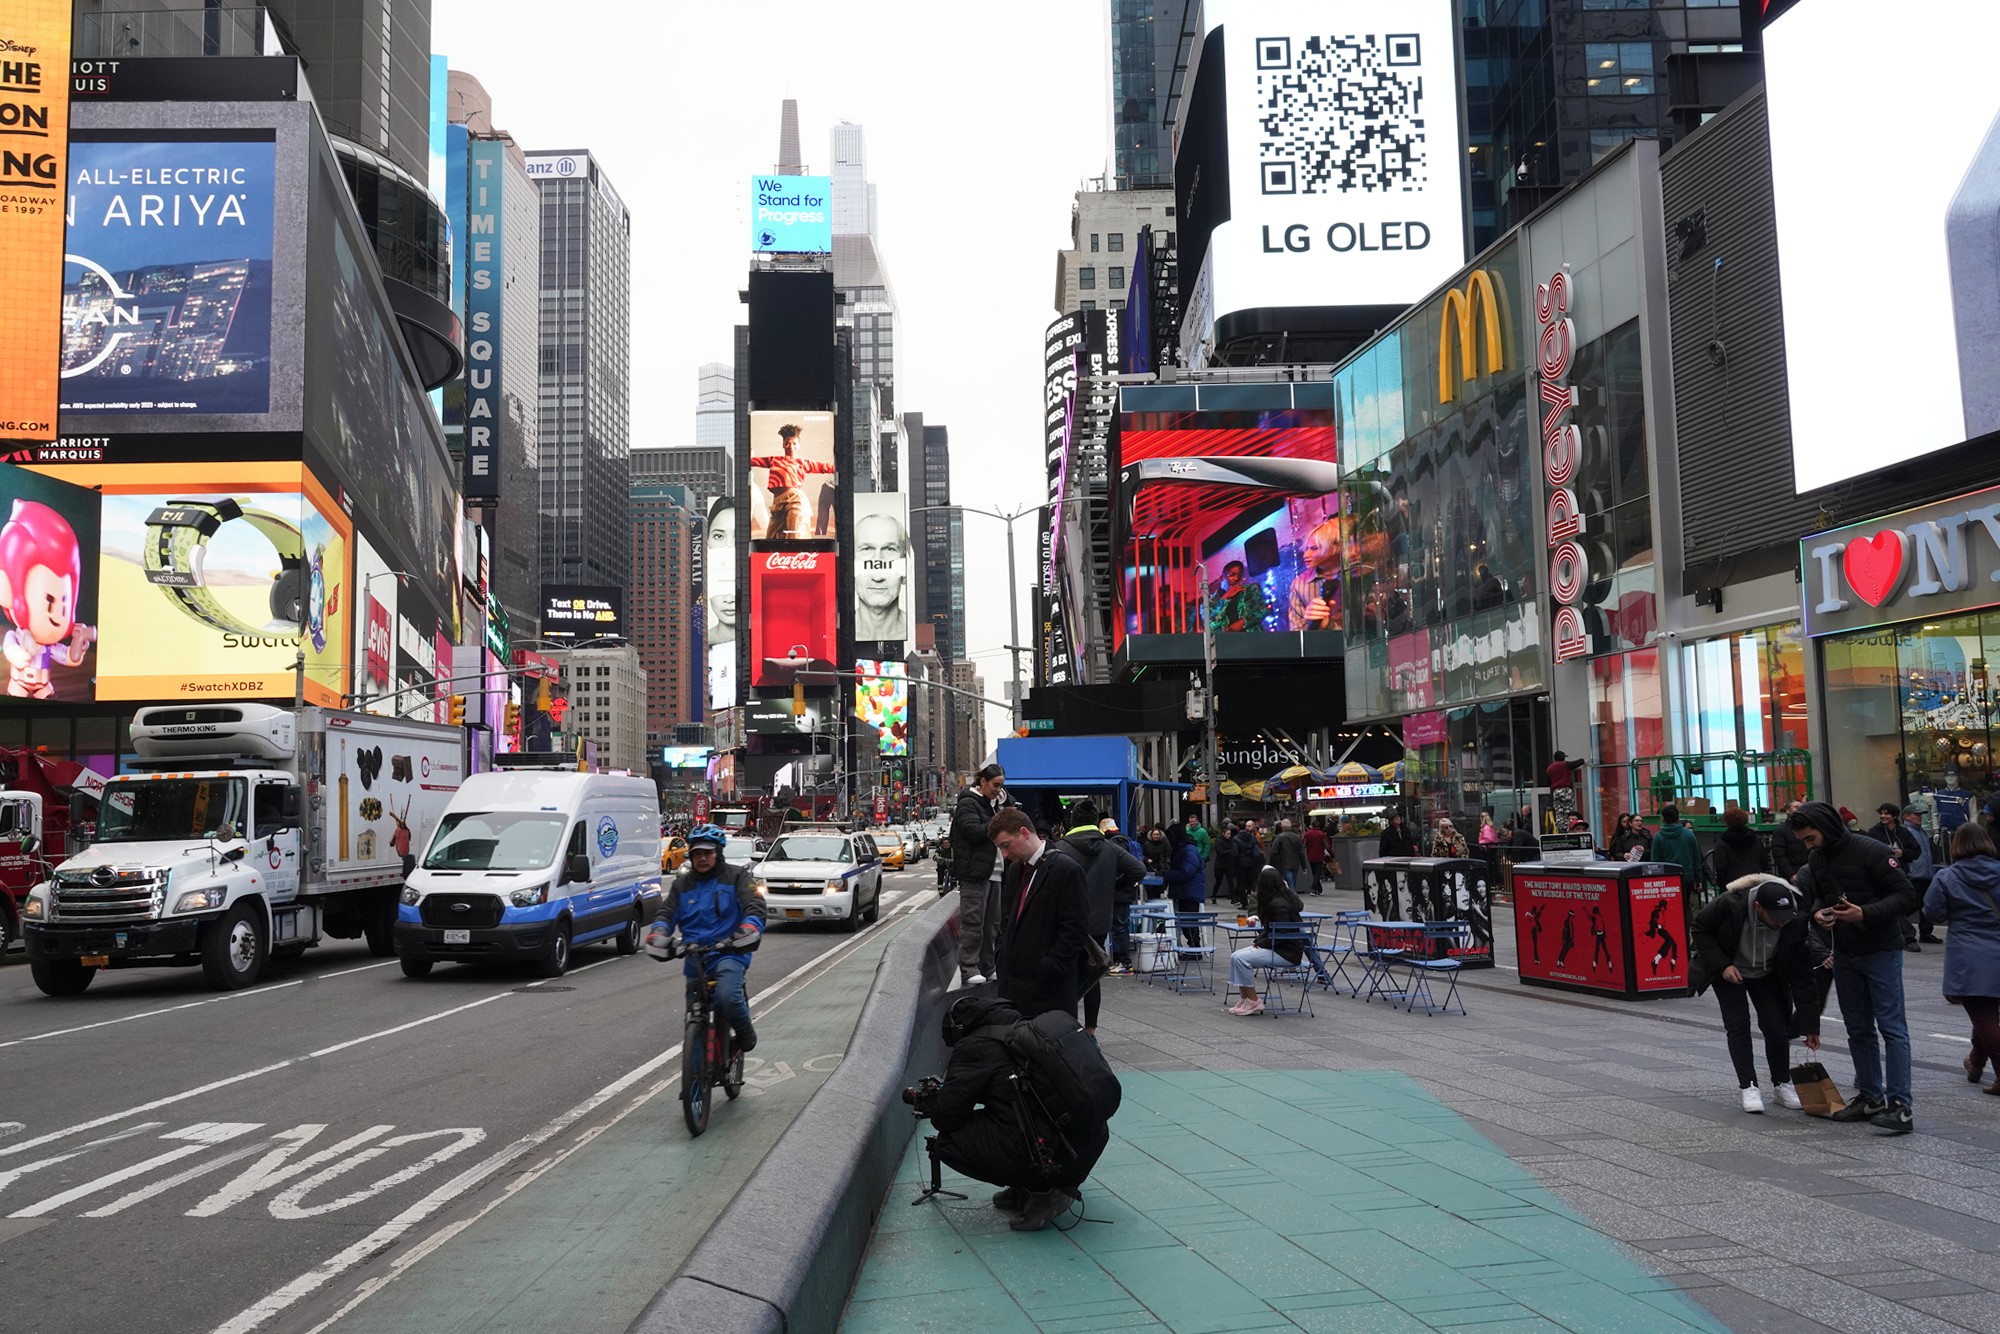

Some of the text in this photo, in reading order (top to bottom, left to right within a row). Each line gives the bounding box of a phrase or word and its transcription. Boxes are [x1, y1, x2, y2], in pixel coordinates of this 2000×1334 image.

[77, 168, 246, 184] ALL-ELECTRIC
[758, 179, 782, 192] We
[758, 193, 824, 206] Stand for
[15, 206, 43, 215] 1997
[102, 194, 246, 226] ARIYA
[758, 208, 825, 226] Progress
[472, 159, 495, 291] TIMES
[1262, 221, 1431, 253] LG OLED
[471, 312, 494, 476] SQUARE
[40, 450, 101, 460] MARQUIS
[766, 552, 818, 570] Coca-Cola
[551, 599, 611, 609] Text OR Drive.
[547, 609, 572, 618] There
[583, 610, 595, 619] No
[180, 681, 263, 692] #SwatchXDBZ
[1217, 744, 1300, 769] sunglass
[1354, 785, 1384, 796] GYRO
